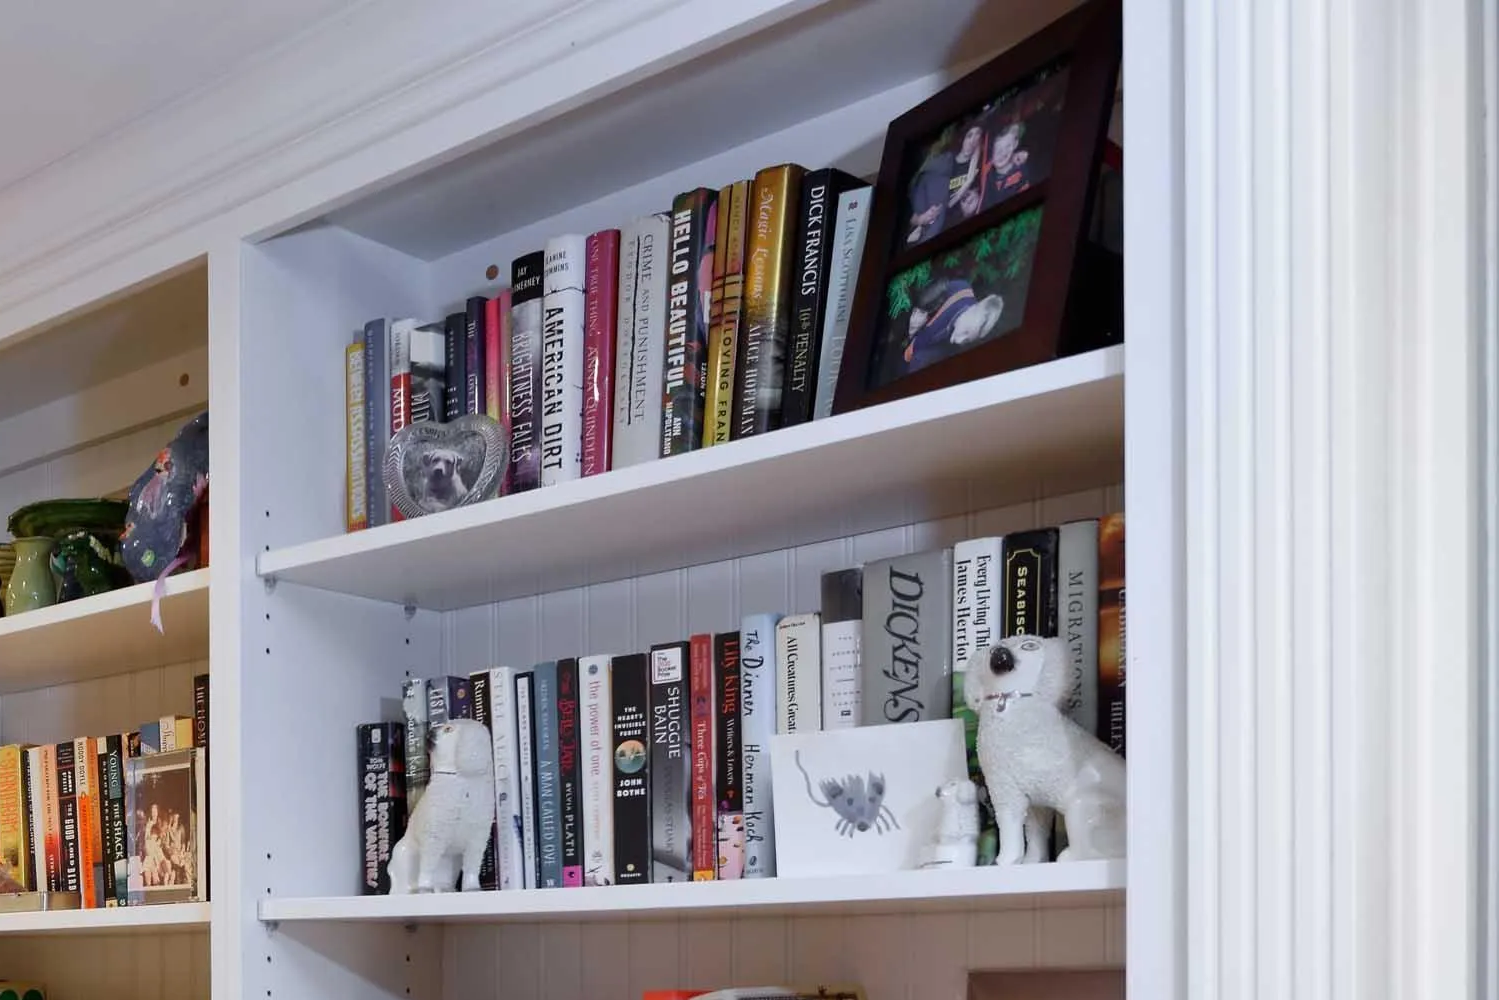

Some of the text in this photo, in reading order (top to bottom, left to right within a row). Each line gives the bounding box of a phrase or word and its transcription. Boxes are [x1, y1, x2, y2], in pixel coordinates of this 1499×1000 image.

[752, 188, 774, 298] Magic Lessons
[802, 186, 825, 295] DICK FRANCIS
[633, 234, 654, 421] CRIME AND PUNISHMENT
[665, 208, 692, 394] HELLO BEAUTIFUL
[511, 332, 534, 464] BRIGHTNESS FALLS
[543, 306, 565, 470] AMERICAN DIRT
[584, 346, 599, 475] ANNA QUINDLEN
[740, 324, 761, 435] ALICE HOFFMAN
[662, 402, 682, 454] ANN NAPOLITANO
[786, 635, 798, 652] All
[882, 566, 925, 721] DICKENS
[956, 560, 972, 661] James Herriot
[430, 688, 445, 716] LISA
[493, 671, 506, 720] STILL
[742, 631, 764, 717] The Dinner
[786, 653, 798, 703] Creatures
[405, 712, 421, 777] Sarah's Key
[588, 680, 602, 776] the power of one
[614, 720, 646, 730] INVISIBLE
[654, 705, 667, 745] BAIN
[667, 687, 682, 759] SHUGGIE
[787, 703, 798, 731] Great
[78, 766, 86, 785] DOYLE
[110, 750, 119, 787] YOUNG
[616, 787, 646, 798] BOYNE
[619, 778, 643, 788] JOHN
[744, 745, 764, 843] Herman Koch
[64, 818, 75, 840] GOOD
[114, 821, 123, 860] SHACK
[364, 773, 379, 889] OF THE VANITIES
[377, 771, 390, 862] THE BONFIRE
[541, 760, 554, 867] A MAN CALLED OVE
[565, 814, 575, 857] PLATH
[66, 868, 77, 891] BIRD
